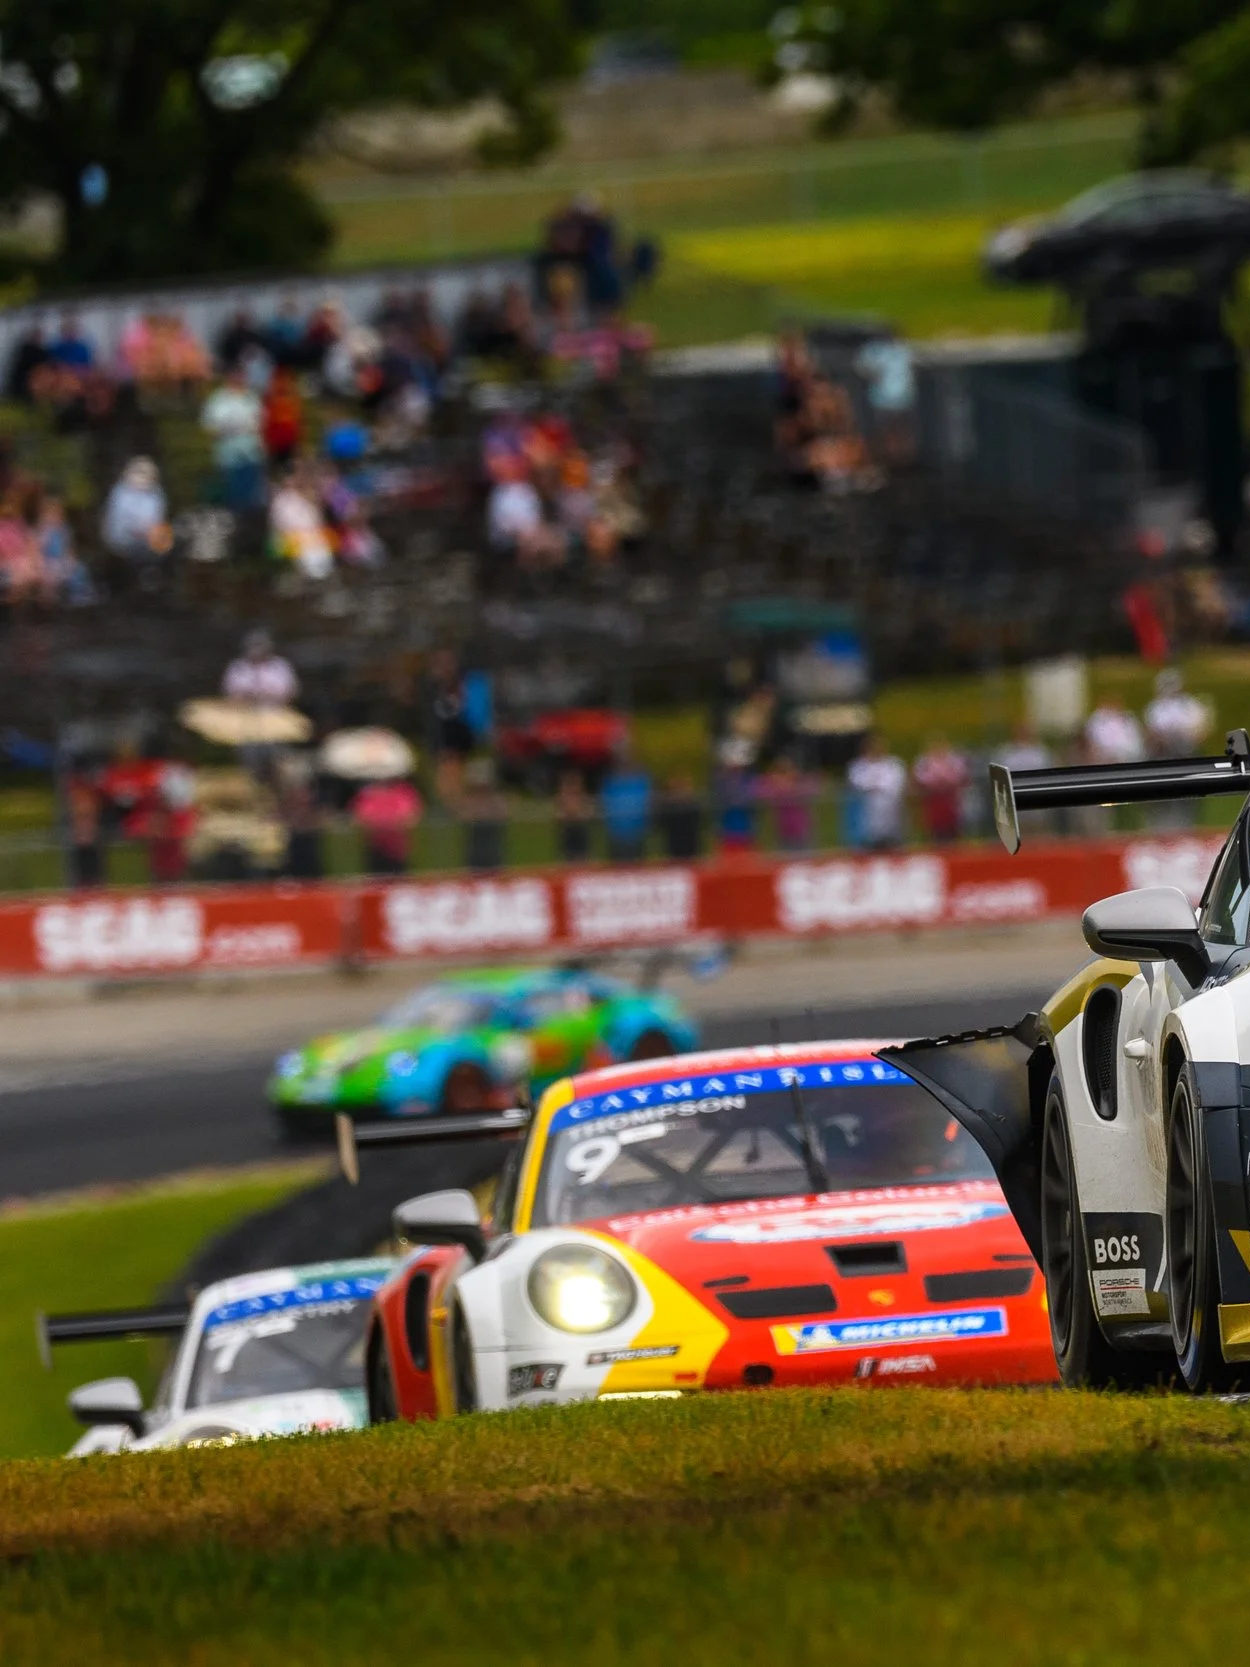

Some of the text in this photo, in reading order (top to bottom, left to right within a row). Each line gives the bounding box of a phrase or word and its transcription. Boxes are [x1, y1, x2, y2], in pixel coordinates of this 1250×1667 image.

[567, 1094, 747, 1142] THOMPSON
[568, 1072, 764, 1119] CAYMAN
[565, 1135, 622, 1186] 9
[1094, 1235, 1141, 1263] BOSS
